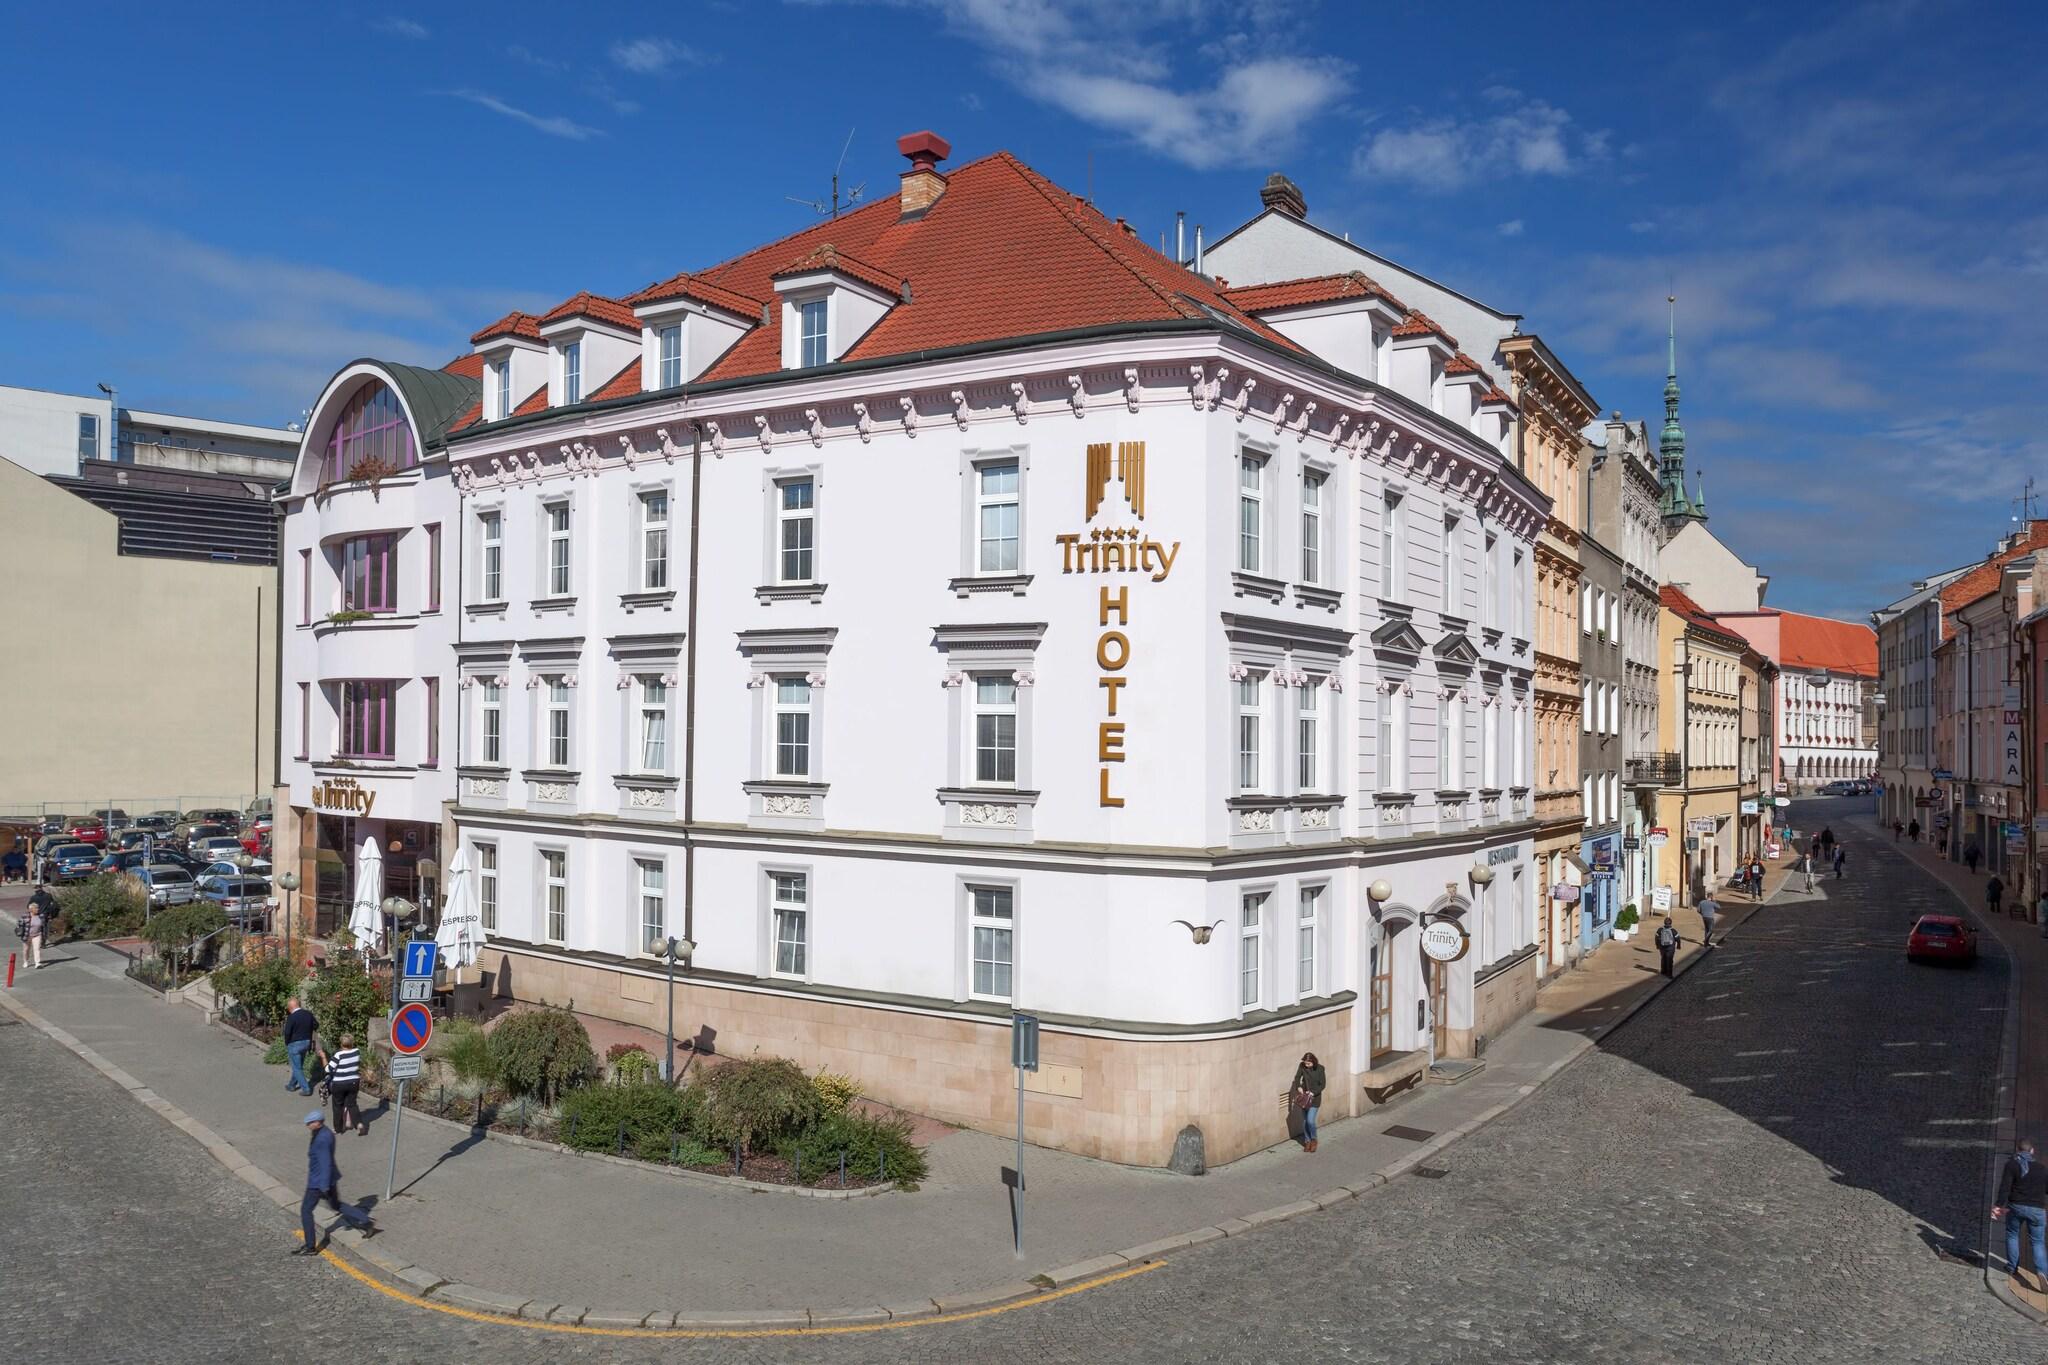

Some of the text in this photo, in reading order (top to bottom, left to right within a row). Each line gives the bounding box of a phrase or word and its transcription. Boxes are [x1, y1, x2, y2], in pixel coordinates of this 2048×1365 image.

[1056, 533, 1181, 583] Trinity
[1097, 586, 1130, 808] HOTEL
[2005, 711, 2019, 775] MARA
[322, 779, 376, 818] Trinity
[1427, 930, 1459, 948] Trinity
